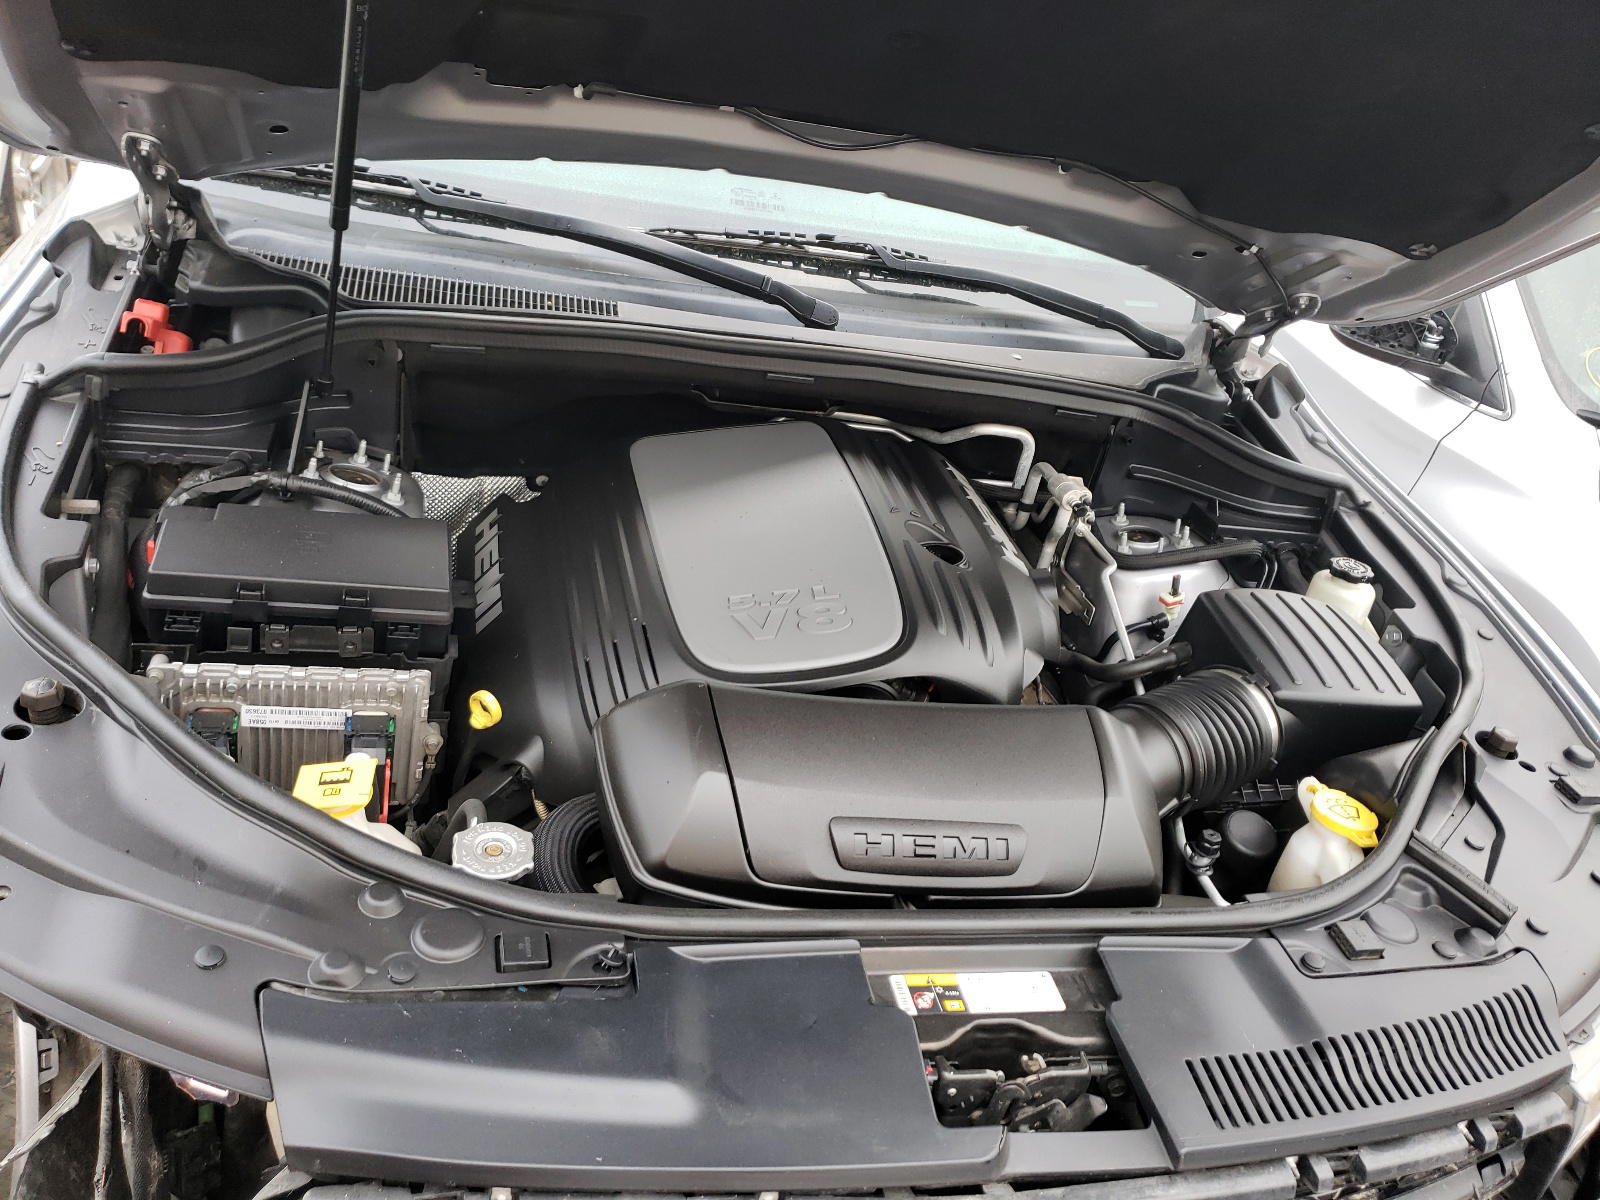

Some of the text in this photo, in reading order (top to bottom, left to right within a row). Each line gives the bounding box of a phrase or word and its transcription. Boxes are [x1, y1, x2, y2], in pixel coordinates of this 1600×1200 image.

[474, 508, 503, 635] HEMI
[728, 601, 853, 641] V8
[853, 832, 1010, 861] HEMI
